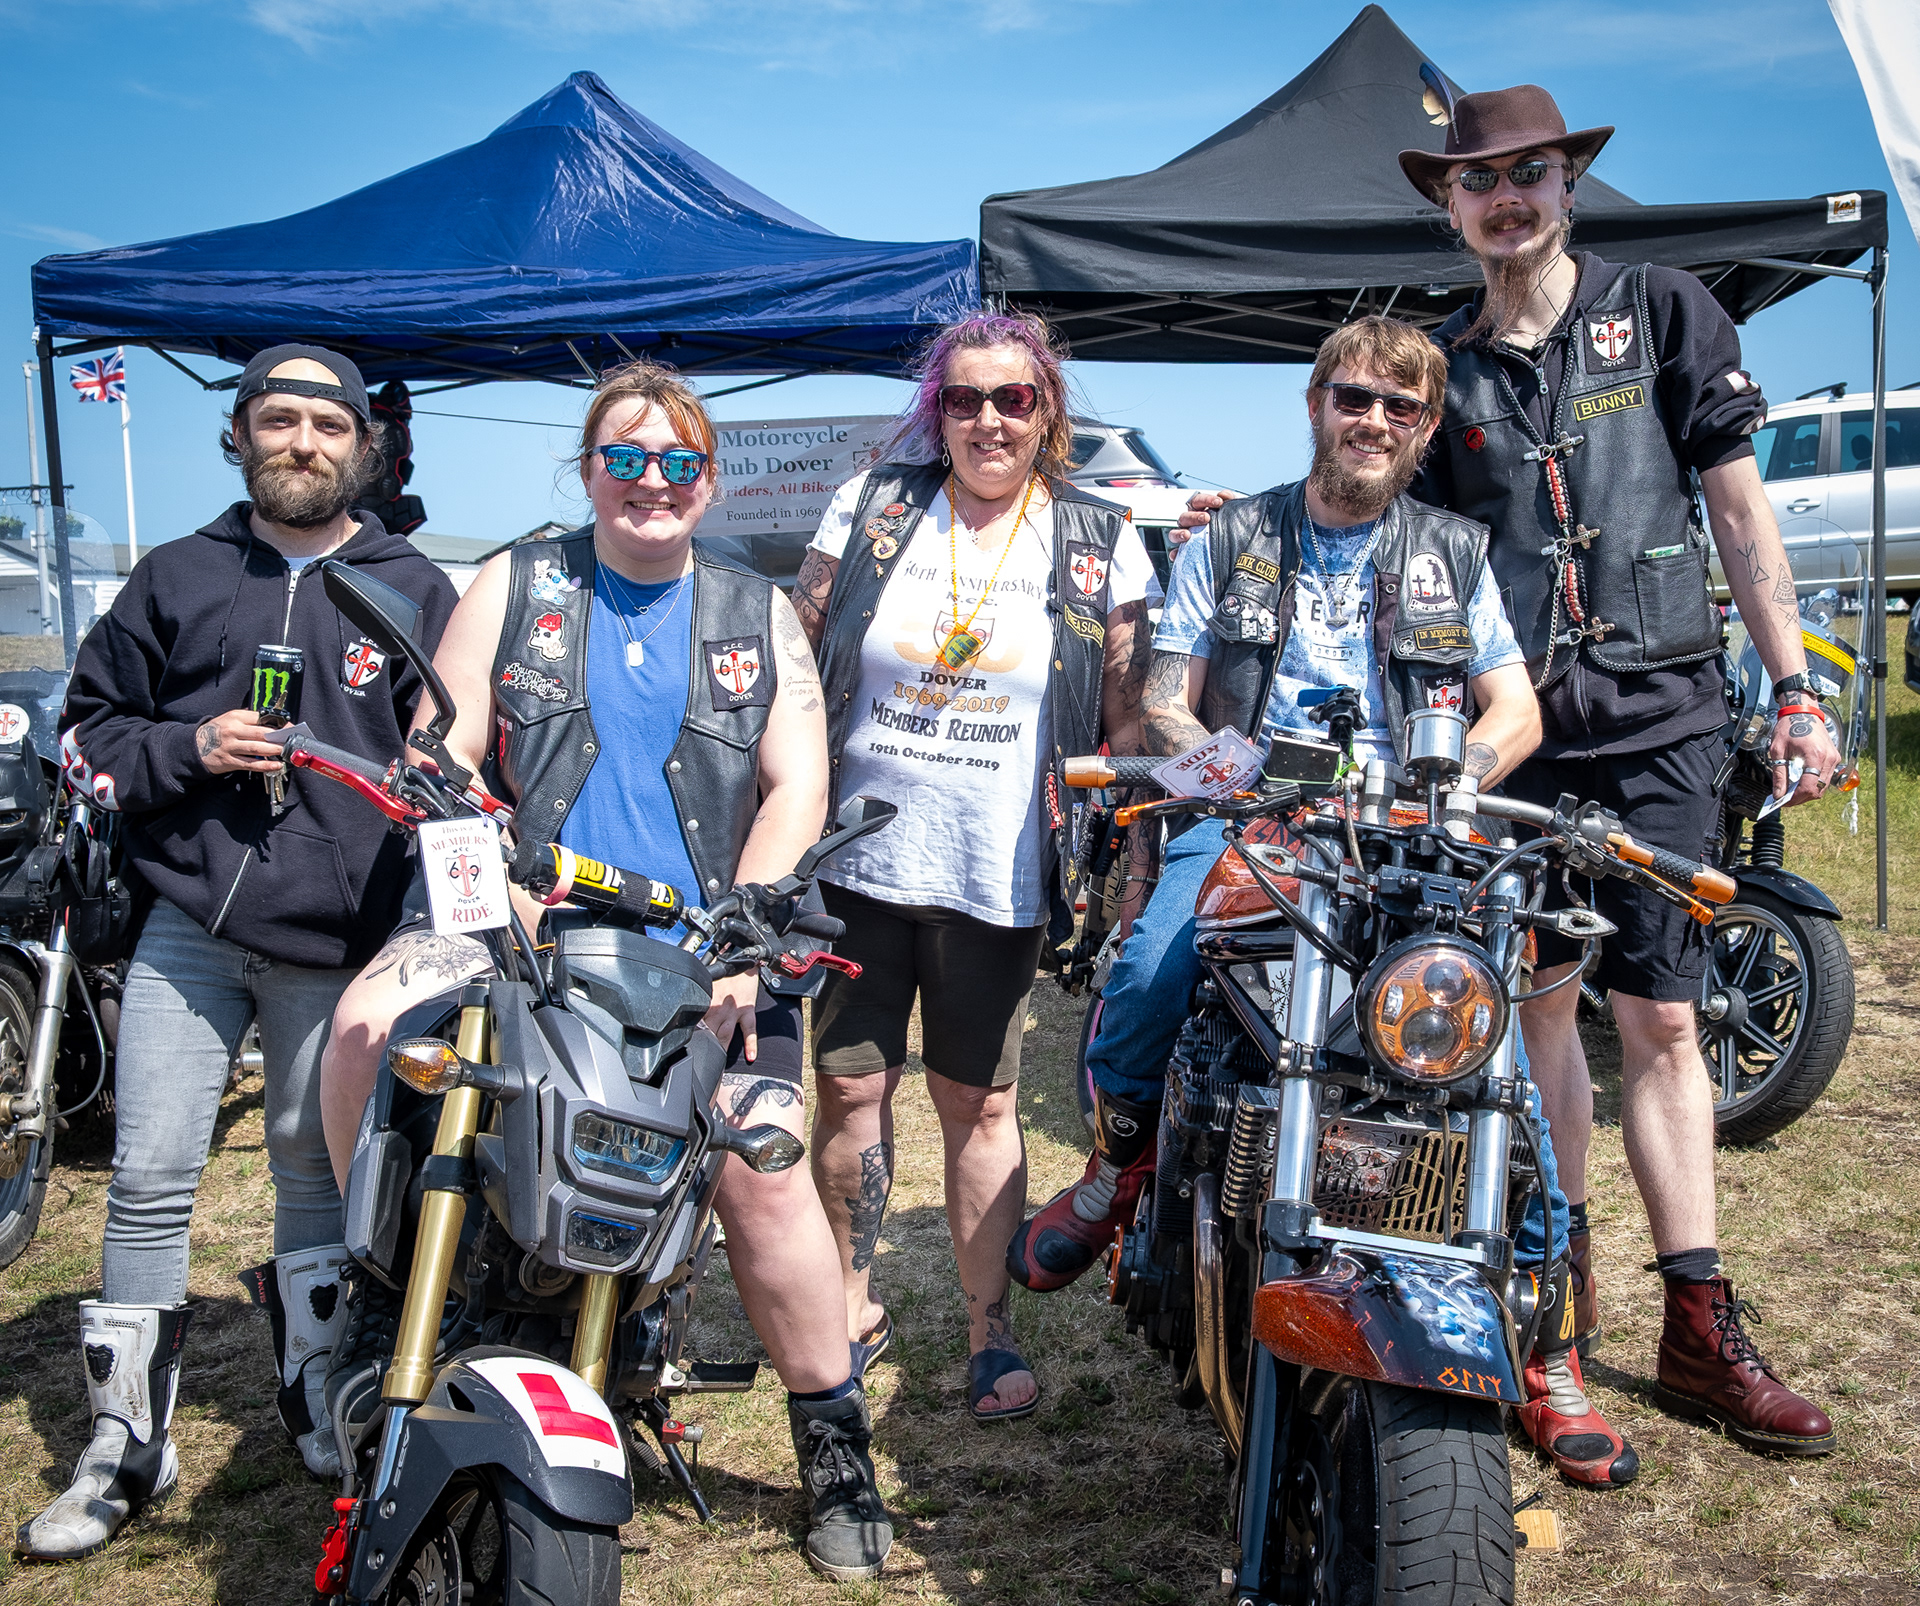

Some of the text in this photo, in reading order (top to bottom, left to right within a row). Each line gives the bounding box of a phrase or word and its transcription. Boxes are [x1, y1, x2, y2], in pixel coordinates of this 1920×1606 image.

[1602, 356, 1627, 367] DOVER
[1580, 390, 1636, 416] BUNNY
[721, 425, 848, 448] Motorcycle
[717, 457, 833, 475] lub Dover
[726, 485, 773, 497] riders,
[777, 483, 797, 494] All
[726, 506, 822, 521] Founded in 1969
[1256, 560, 1277, 579] CLUB
[1076, 592, 1098, 602] DOVER
[1430, 628, 1461, 639] MEMORY
[920, 671, 987, 690] DOVER
[729, 692, 754, 702] DOVER
[893, 681, 1011, 714] 1969-2019
[871, 697, 1022, 743] MEMBERS REUNION
[869, 742, 1001, 771] 19th October 2019
[452, 903, 493, 923] RIDE
[516, 1373, 619, 1449] L
